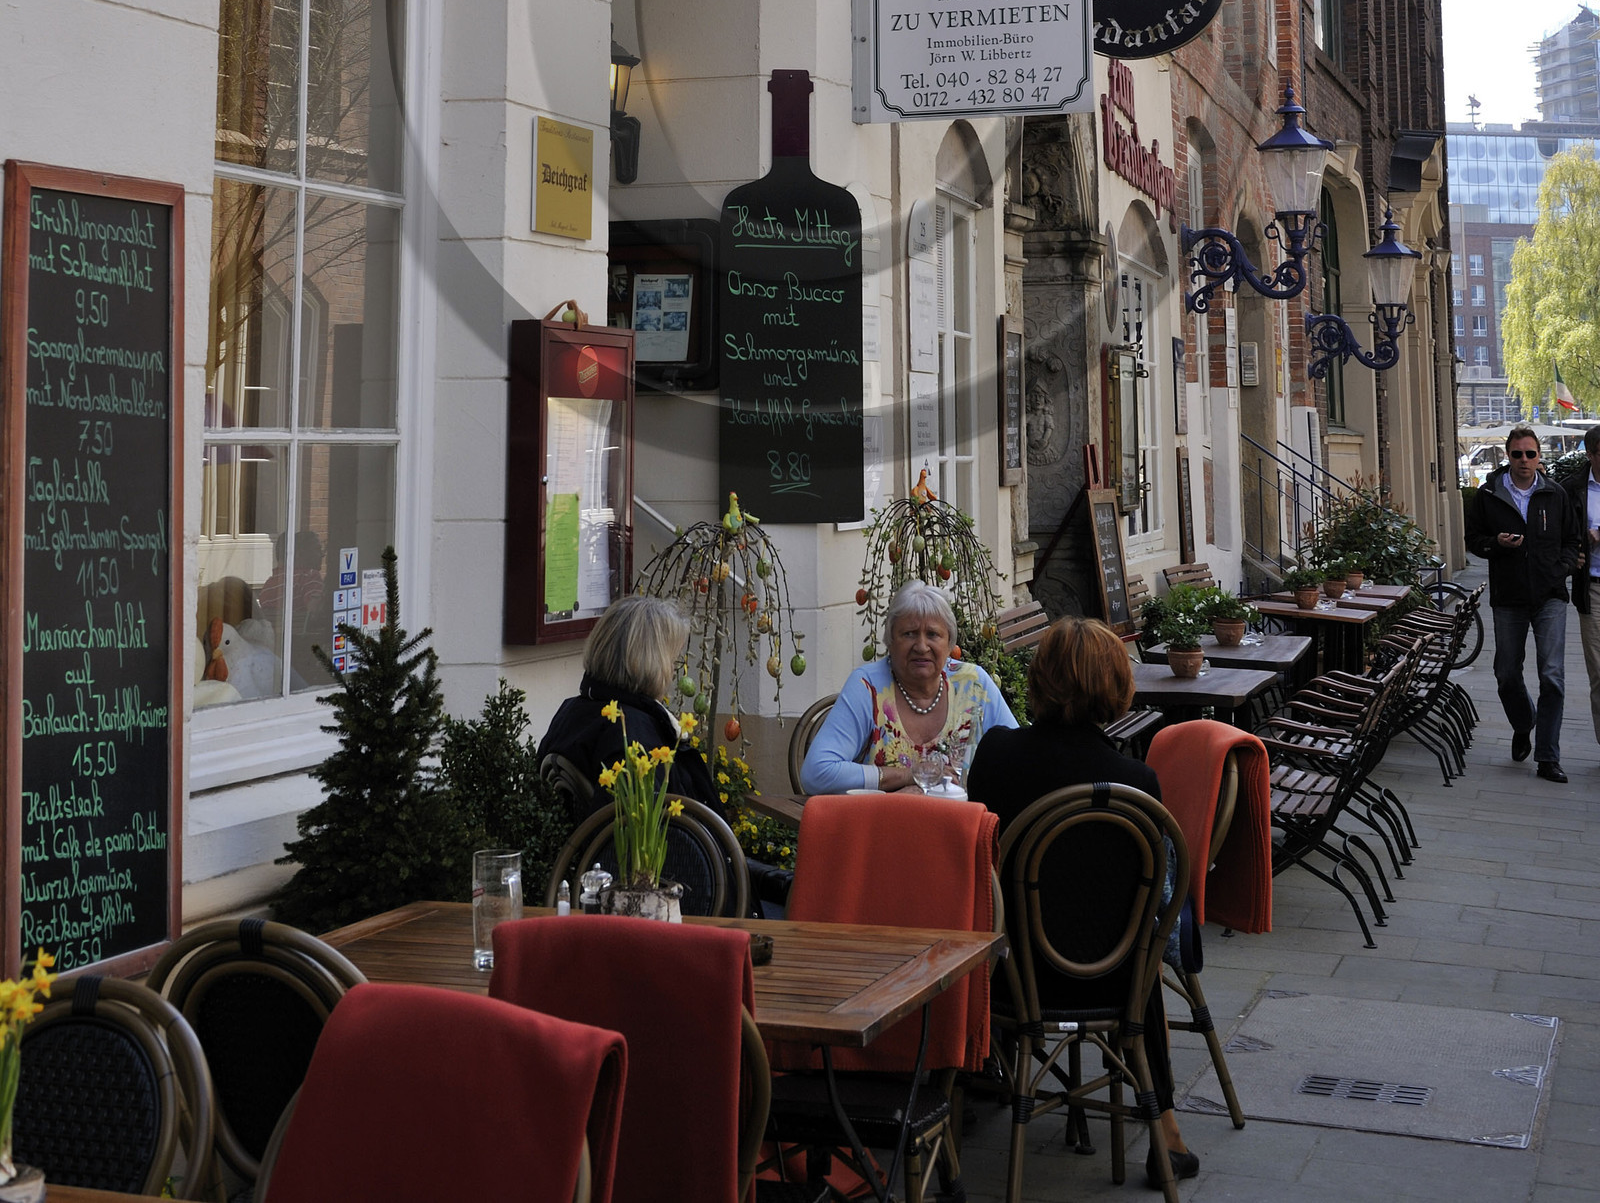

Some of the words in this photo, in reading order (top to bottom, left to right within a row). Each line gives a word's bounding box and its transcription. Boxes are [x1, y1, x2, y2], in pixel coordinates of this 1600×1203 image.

[891, 13, 920, 32] ZU
[928, 3, 1070, 29] VERMIETEN
[927, 32, 1034, 49] Immobilien-Büro
[929, 52, 956, 66] Jörn
[961, 50, 976, 62] W.
[980, 48, 1032, 62] Libbertz
[900, 73, 930, 90] Tel.
[936, 71, 970, 88] 040
[987, 69, 1008, 85] 82
[1014, 68, 1037, 84] 84
[1043, 66, 1063, 82] 27
[912, 91, 949, 108] 0172
[967, 89, 996, 105] 432
[1002, 87, 1025, 104] 80
[1031, 86, 1050, 103] 47
[541, 162, 588, 193] Deichgraf
[30, 195, 157, 261] Frühlingssalat
[727, 205, 786, 240] Heute
[791, 207, 859, 267] Mittag
[28, 237, 57, 273] mit
[60, 242, 153, 305] Schweinefilet
[728, 270, 778, 299] Osso
[784, 271, 845, 303] Bucco
[75, 289, 108, 327] 9,50
[764, 303, 800, 326] mit
[27, 327, 165, 388] Spargelcremesuppe
[724, 332, 860, 380] Schmorgemüse
[26, 369, 54, 406] mit
[763, 362, 798, 387] und
[78, 420, 113, 456] 7,50
[29, 456, 110, 524] Tagliatelle
[25, 512, 51, 550] mit
[76, 557, 119, 598] 11,50
[343, 574, 354, 583] PAY
[344, 553, 353, 570] V
[65, 651, 95, 698] auf
[72, 741, 116, 777] 15,50
[22, 779, 104, 834] Hüftsteak
[22, 824, 49, 863] mit
[85, 820, 103, 857] de
[132, 810, 167, 852] Butter
